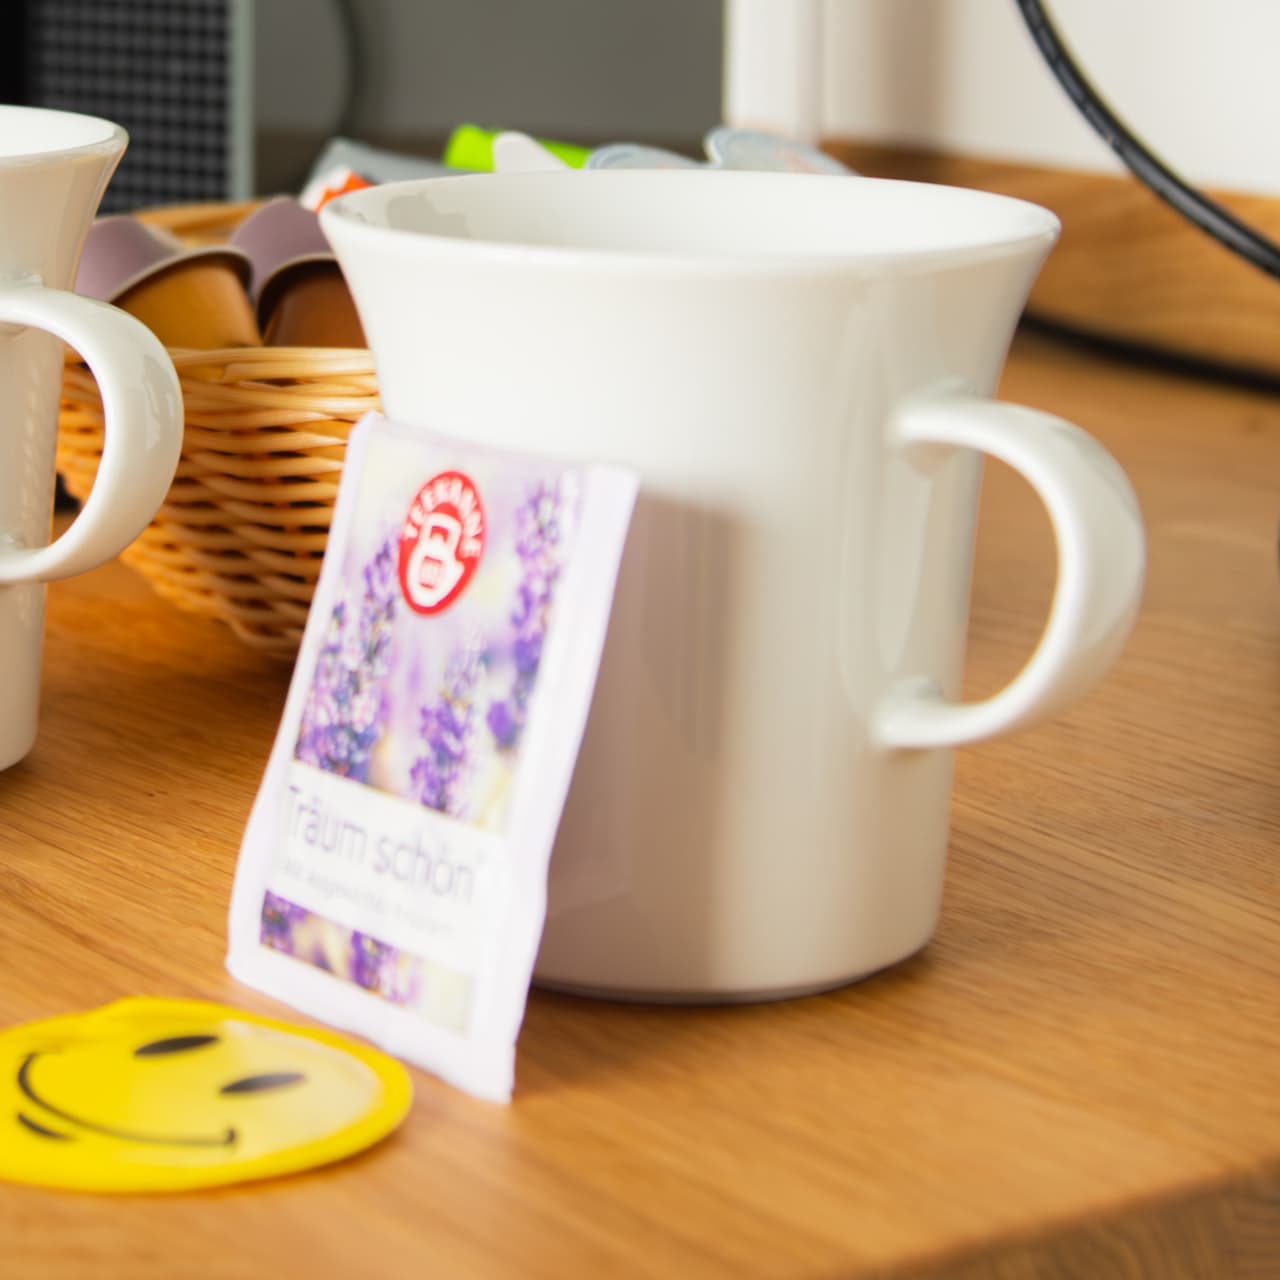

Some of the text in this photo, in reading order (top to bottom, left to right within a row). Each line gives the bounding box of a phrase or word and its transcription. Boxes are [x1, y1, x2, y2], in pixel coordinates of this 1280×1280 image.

[404, 477, 483, 558] TEEKANNE
[284, 783, 369, 864] Träum
[371, 830, 475, 906] schön
